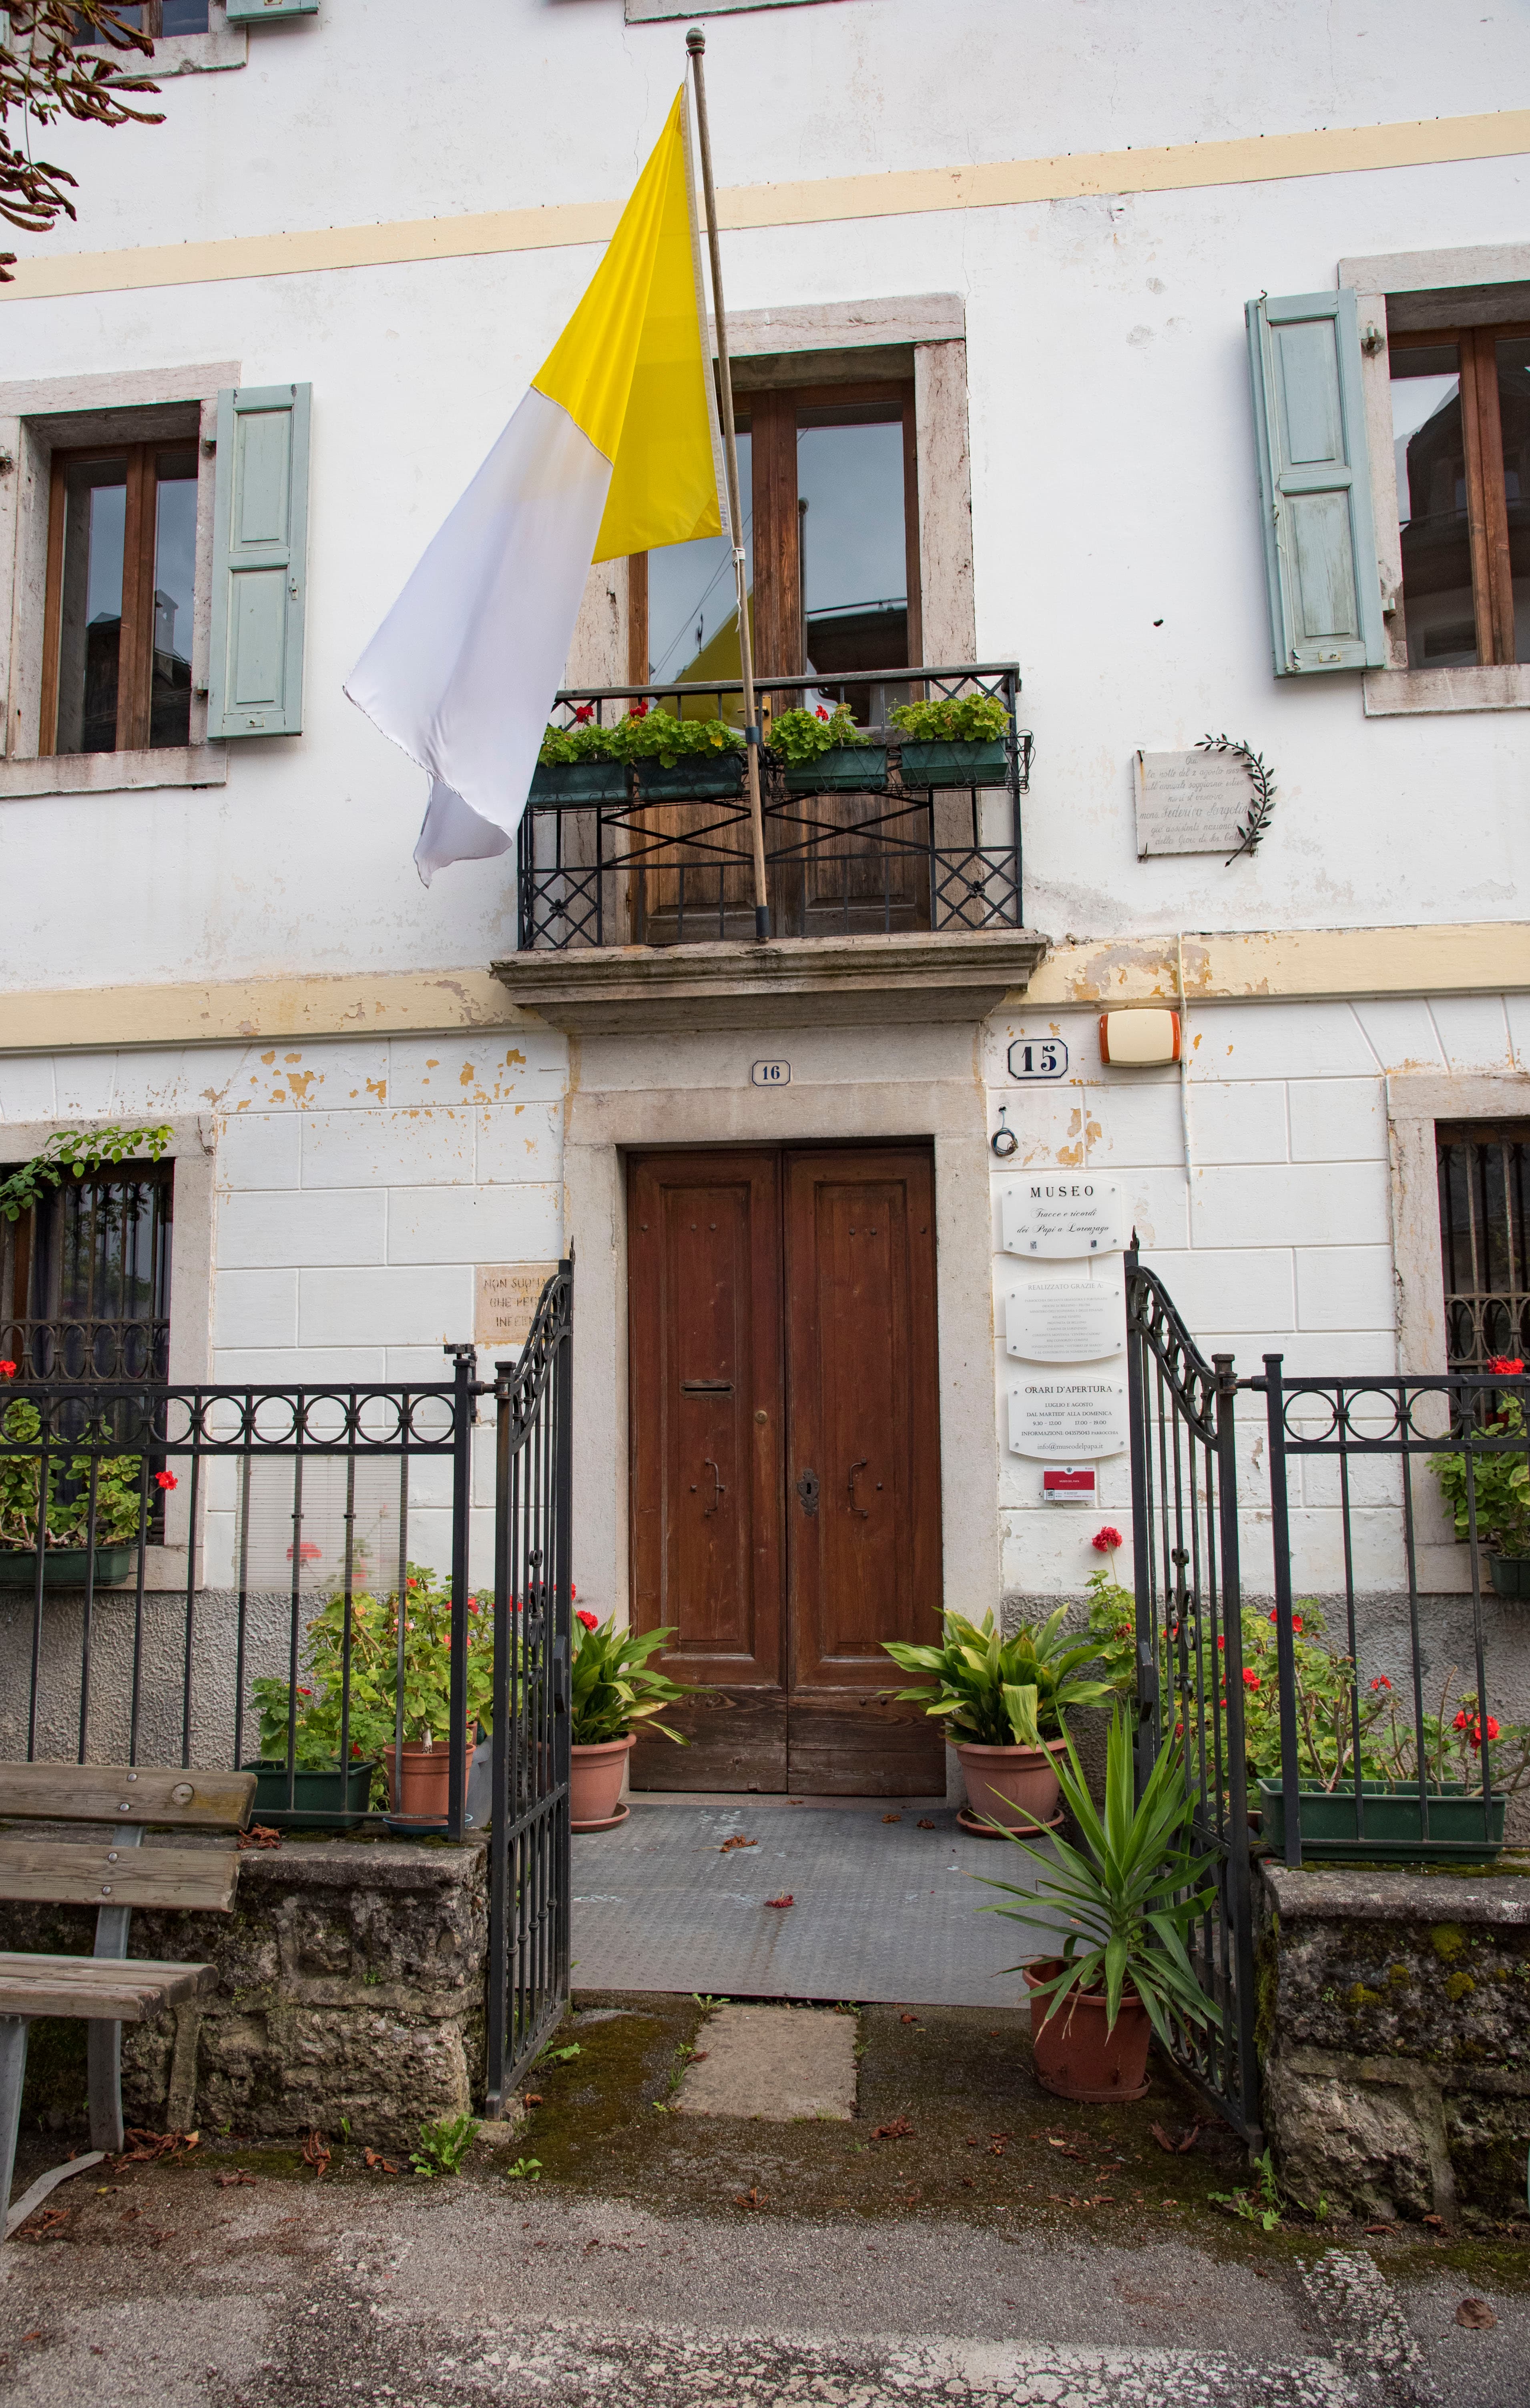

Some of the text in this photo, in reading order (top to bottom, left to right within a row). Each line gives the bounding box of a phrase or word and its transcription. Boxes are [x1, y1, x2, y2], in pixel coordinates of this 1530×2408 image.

[1179, 767, 1190, 777] del
[1199, 766, 1224, 779] agosto
[1161, 805, 1203, 818] Federico
[1021, 1045, 1057, 1072] 15
[763, 1066, 780, 1080] 16
[1030, 1185, 1094, 1198] MUSEO
[1030, 1207, 1061, 1218] Tracce
[1070, 1208, 1097, 1217] ricordi
[1017, 1225, 1029, 1234] dei
[1032, 1224, 1056, 1236] Papi
[1066, 1222, 1109, 1235] Lorenzago
[496, 1316, 533, 1327] INFERN
[1056, 1385, 1112, 1393] D'APERTURA
[1037, 1442, 1103, 1451] info@museodelpapa.it
